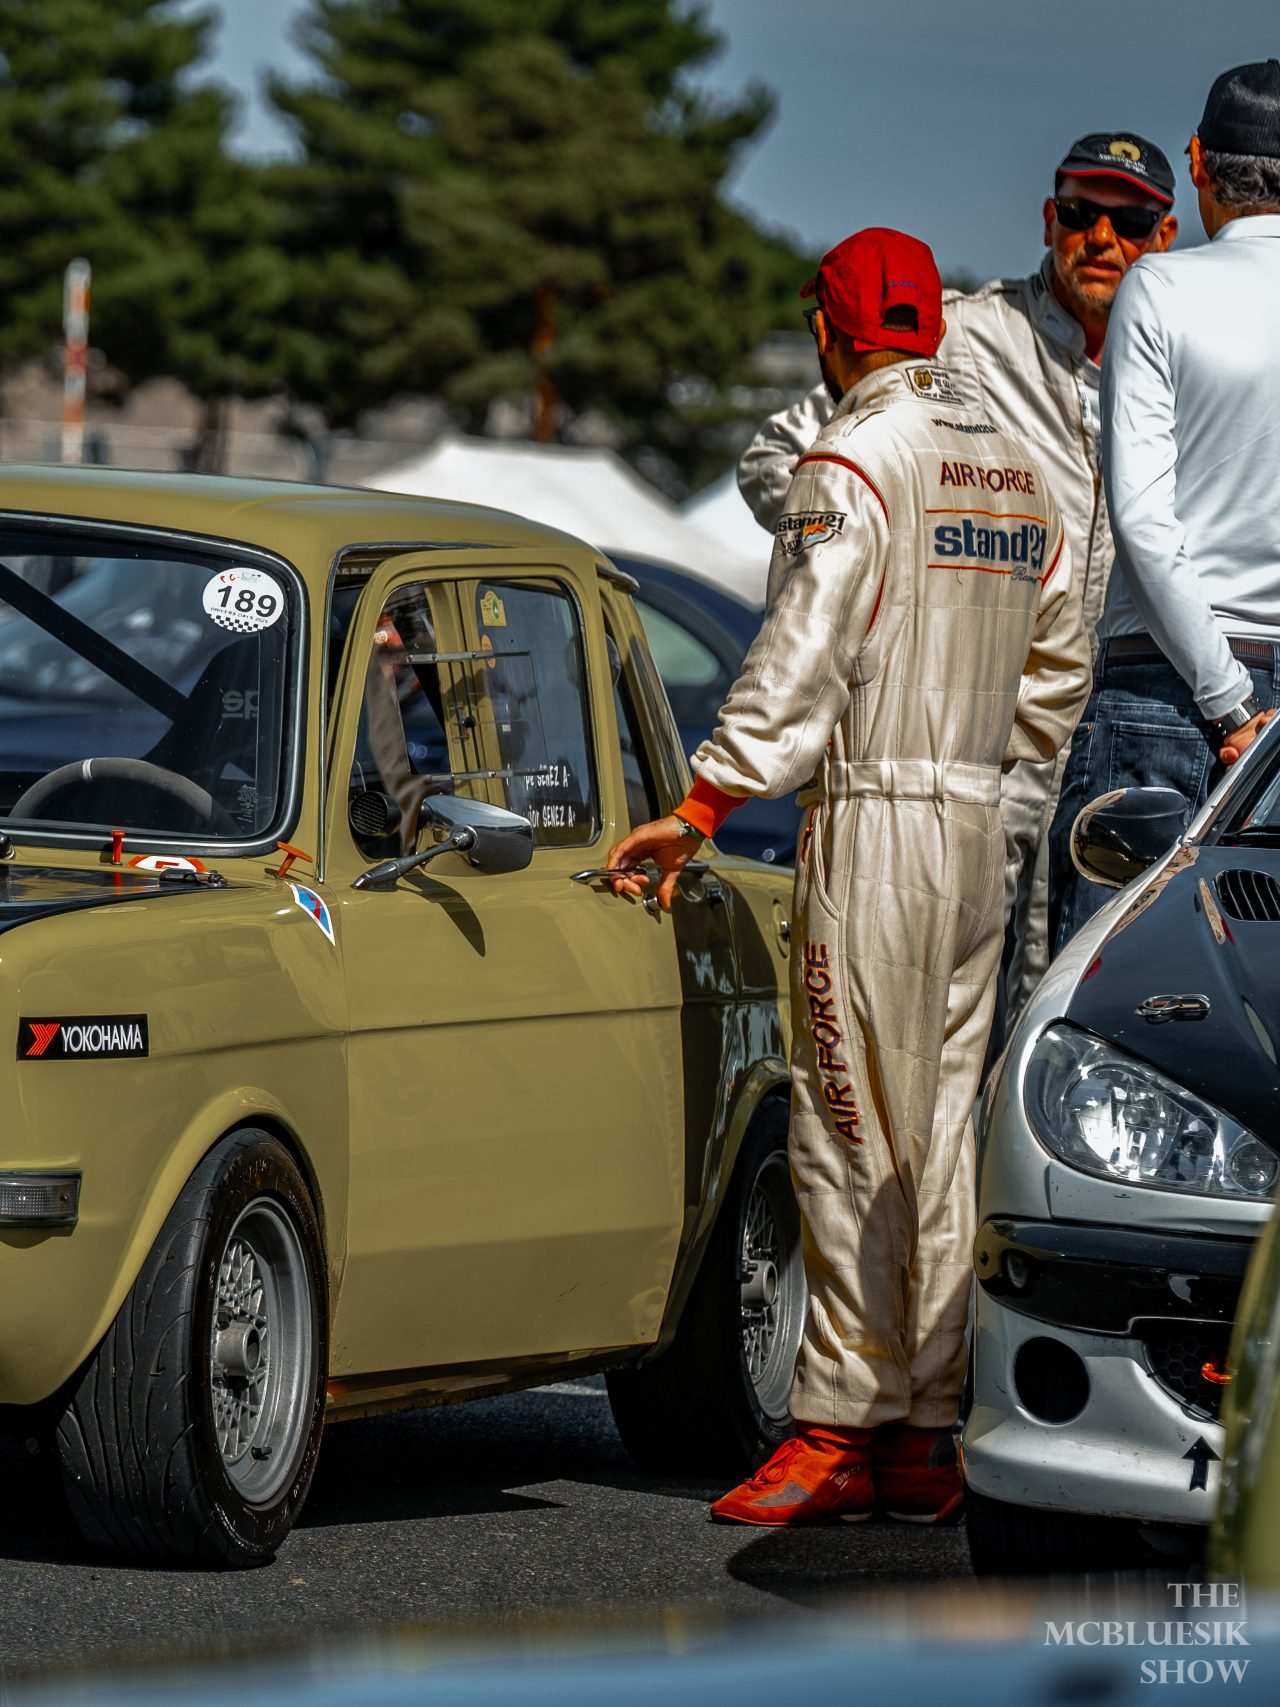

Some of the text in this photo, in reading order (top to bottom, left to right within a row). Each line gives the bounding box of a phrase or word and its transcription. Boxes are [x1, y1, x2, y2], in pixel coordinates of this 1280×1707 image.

[939, 459, 1037, 496] AIR FORCE
[778, 513, 845, 533] stand21
[934, 518, 1047, 570] stand21
[217, 585, 277, 618] 189
[61, 1024, 143, 1052] YOKOHAMA
[804, 940, 863, 1144] AIR FORCE
